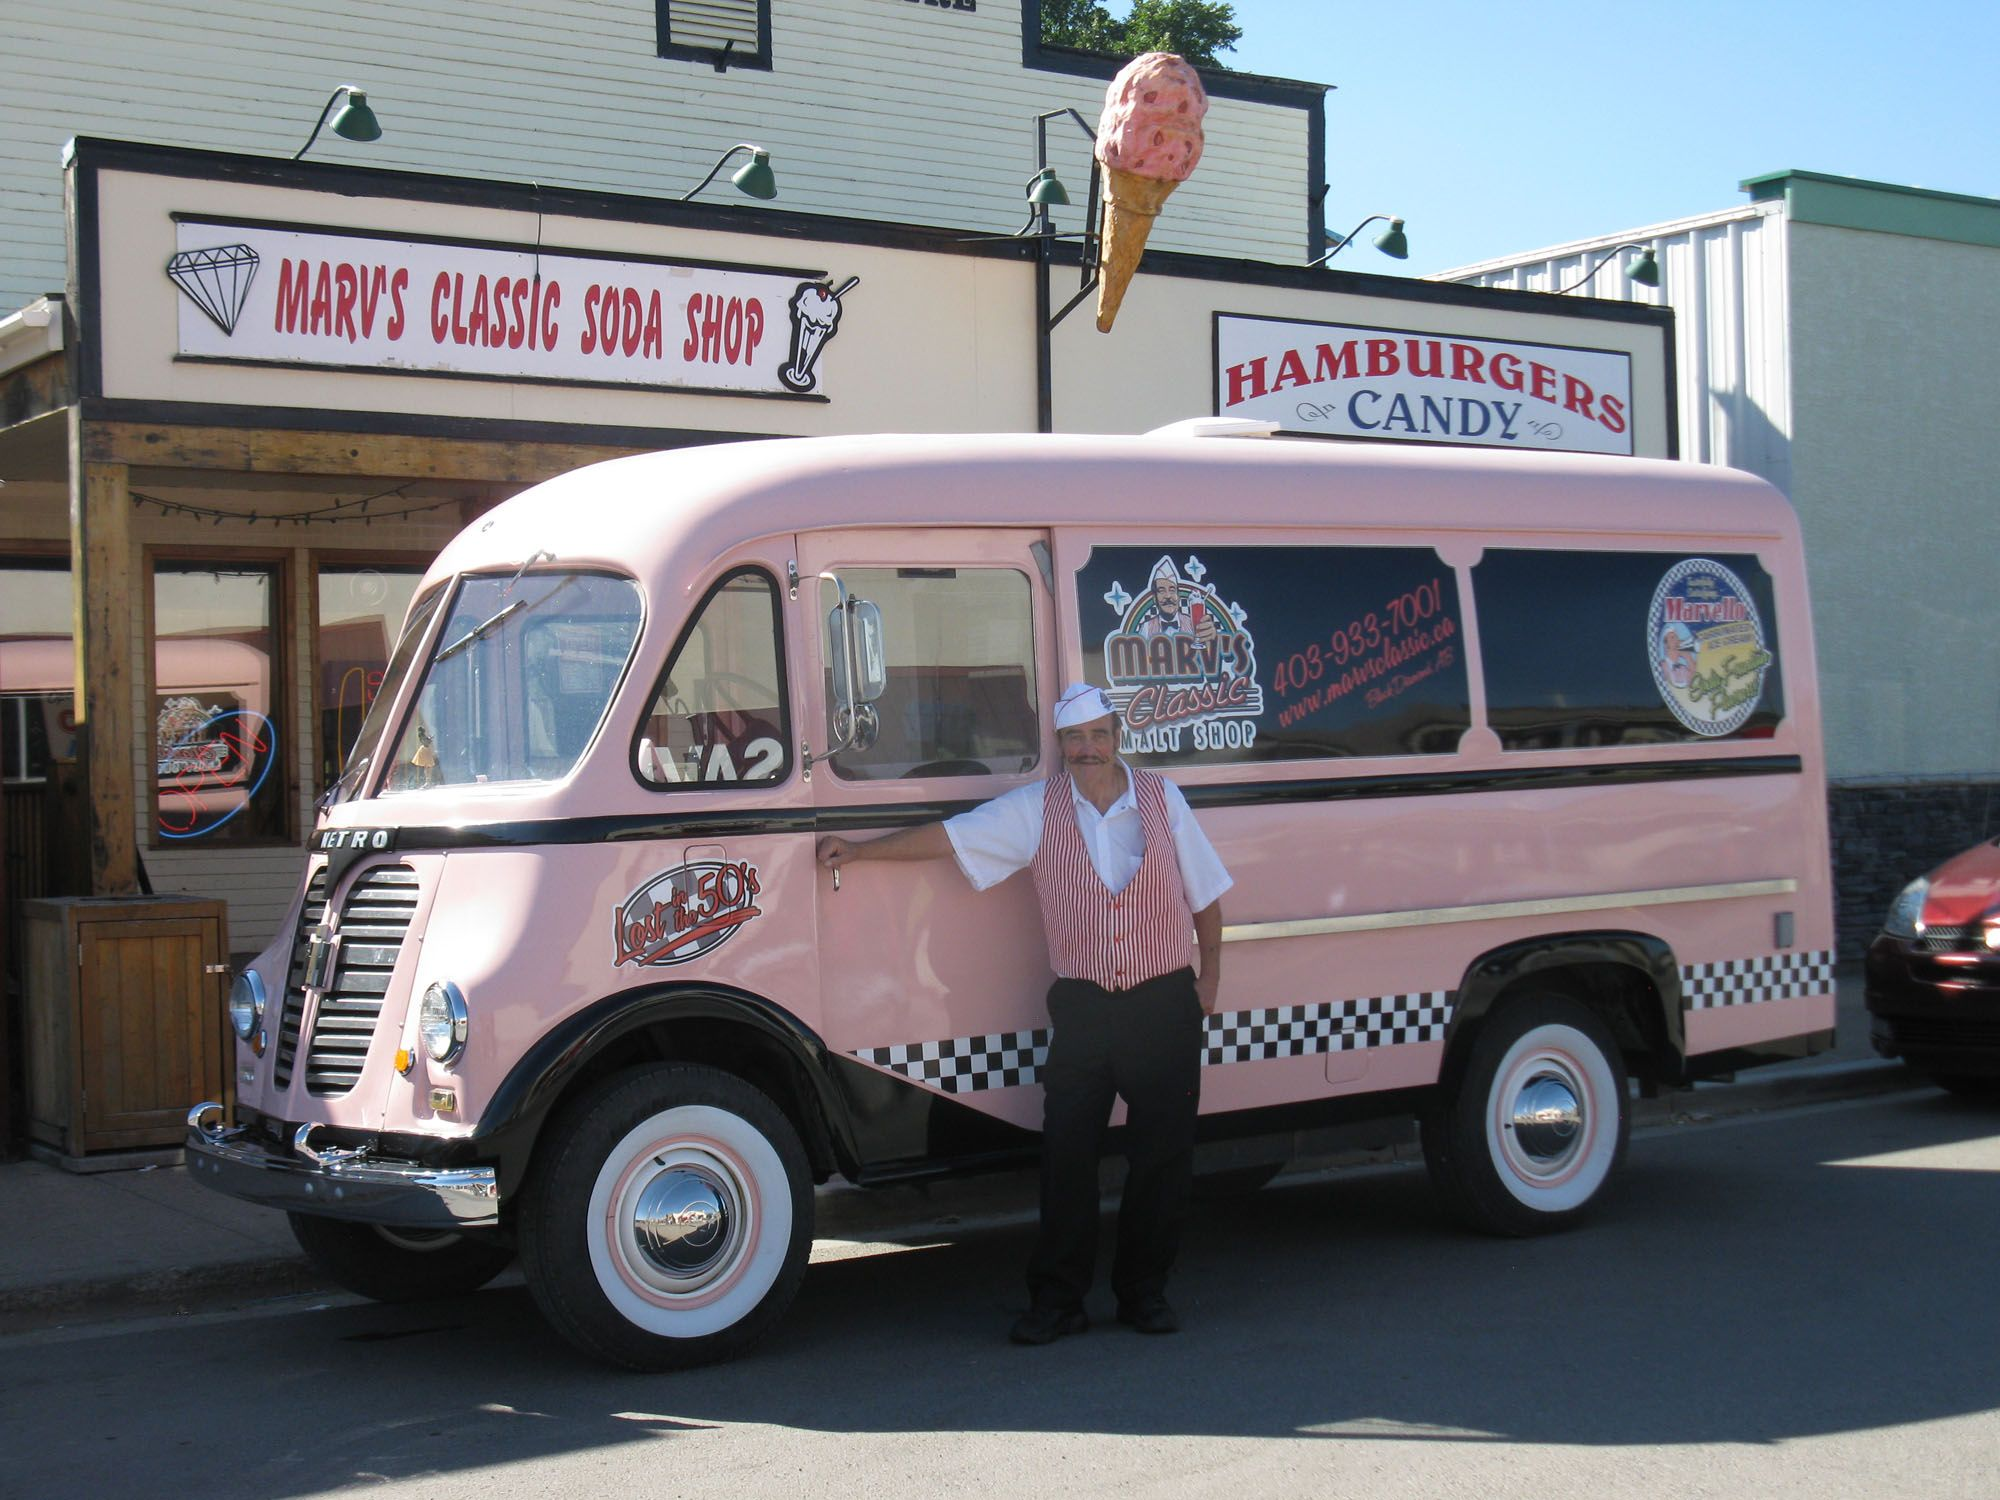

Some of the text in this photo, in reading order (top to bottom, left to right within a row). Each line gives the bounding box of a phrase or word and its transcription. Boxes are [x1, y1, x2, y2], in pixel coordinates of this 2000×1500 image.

[274, 258, 765, 366] MARV'S CLASSIC SODA SHOP
[1225, 338, 1626, 434] HAMBURGERS
[1347, 389, 1523, 440] CANDY
[1109, 633, 1252, 679] MARV'S
[1274, 578, 1441, 696] 403-933-7001
[1119, 720, 1257, 753] MALT SHOP
[1127, 672, 1249, 730] Classic
[615, 862, 761, 967] Lost in the 50's
